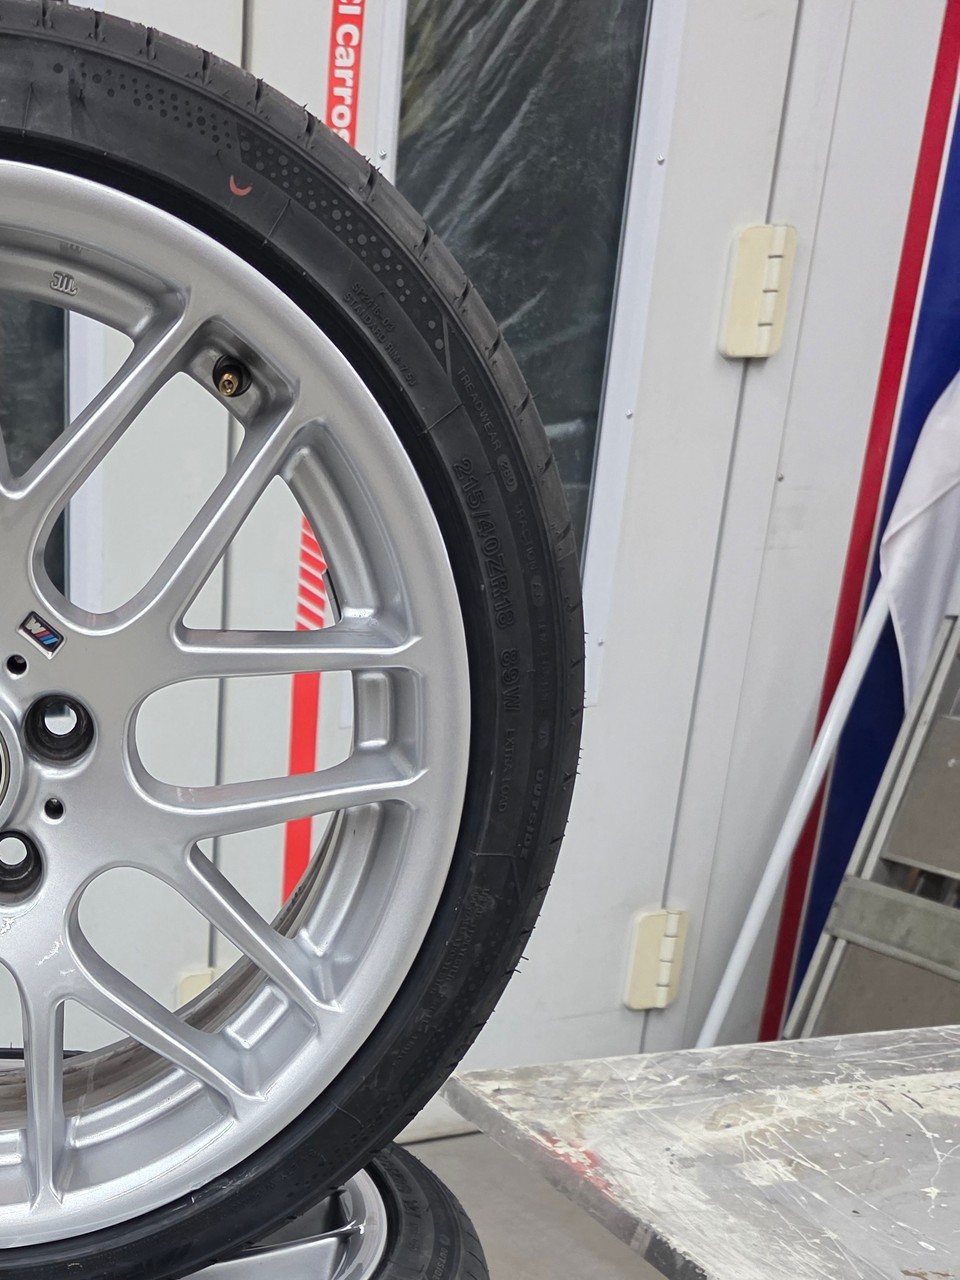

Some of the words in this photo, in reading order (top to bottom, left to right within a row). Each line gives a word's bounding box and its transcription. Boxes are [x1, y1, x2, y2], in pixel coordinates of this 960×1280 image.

[343, 291, 389, 345] STANDARD
[456, 366, 501, 451] TREADWEAR
[498, 455, 516, 489] 280
[515, 499, 537, 573] TRACTION
[453, 457, 515, 629] 215/40ZR18
[500, 647, 520, 713] 89W
[501, 725, 516, 772] EXTRA
[496, 776, 512, 813] LOAD
[518, 769, 546, 860] OUTSIDE
